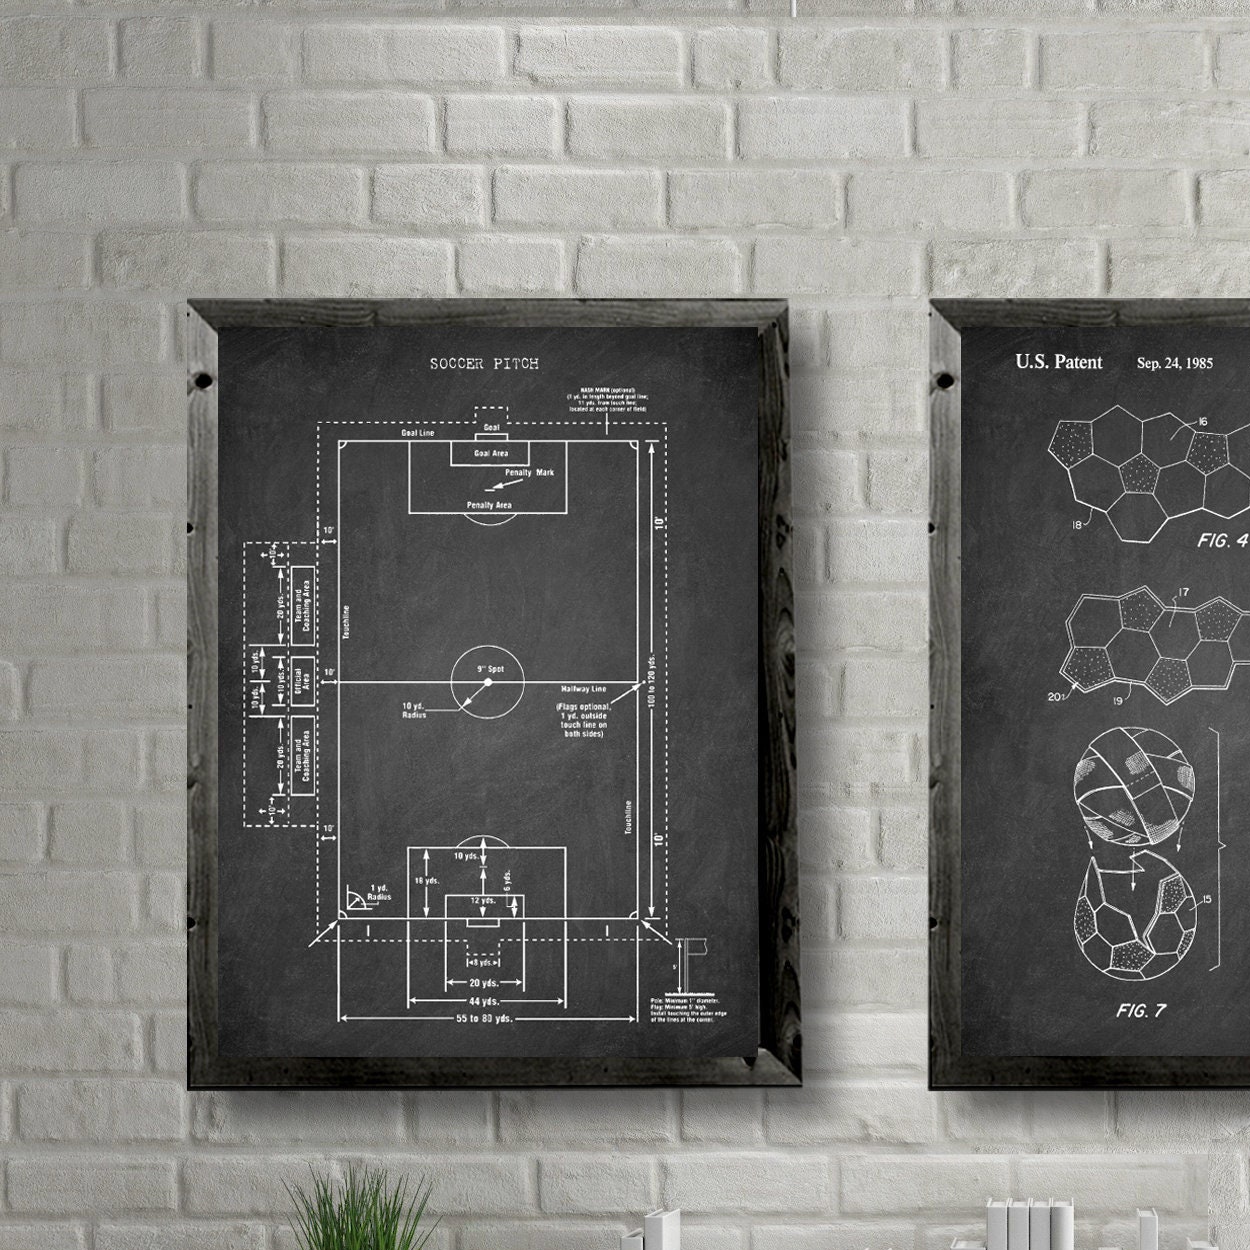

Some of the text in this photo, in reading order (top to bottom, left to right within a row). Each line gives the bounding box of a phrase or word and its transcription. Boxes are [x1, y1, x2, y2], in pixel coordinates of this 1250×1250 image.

[430, 356, 540, 370] SOCCER PITCH
[1015, 353, 1050, 370] U.S.
[1054, 353, 1104, 370] Patent
[1136, 356, 1162, 372] Sep.
[1164, 356, 1183, 371] 24,
[1186, 356, 1214, 370] 1985
[1198, 416, 1208, 427] 16
[401, 428, 435, 437] Goal Line
[483, 423, 501, 432] Goal
[473, 449, 509, 458] Goal Area
[505, 468, 555, 478] Penalty Mark
[466, 500, 513, 511] Penalty Area
[1072, 520, 1083, 530] 18
[1196, 532, 1250, 549] FIG. 4
[1178, 587, 1190, 597] 17
[294, 588, 302, 623] Team and
[302, 580, 311, 632] Coaching Area
[276, 609, 284, 619] 20
[341, 604, 350, 640] Touchline
[487, 664, 505, 674] Spot
[301, 673, 310, 691] Area
[560, 685, 607, 694] Halfway Line
[1047, 691, 1062, 702] 20
[1113, 696, 1124, 706] 19
[402, 701, 425, 712] 10 yd.
[402, 710, 427, 719] Radius
[560, 711, 608, 721] 1 yd. outside
[560, 720, 582, 729] touch
[582, 720, 597, 729] line
[564, 729, 604, 739] both sides)
[624, 800, 632, 835] Touchline
[454, 851, 480, 862] 10 yds.
[424, 876, 440, 886] yds.
[503, 869, 512, 885] yds.
[370, 883, 388, 893] 1 yd.
[366, 892, 392, 901] Radius
[470, 896, 497, 906] 12 yds.
[1201, 894, 1213, 904] 15
[479, 958, 493, 968] yds.
[469, 978, 500, 990] 20 yds.
[468, 996, 500, 1008] 44 yds.
[1115, 1002, 1168, 1019] FIG. 7
[456, 1013, 514, 1025] 55 to 80 yds.
